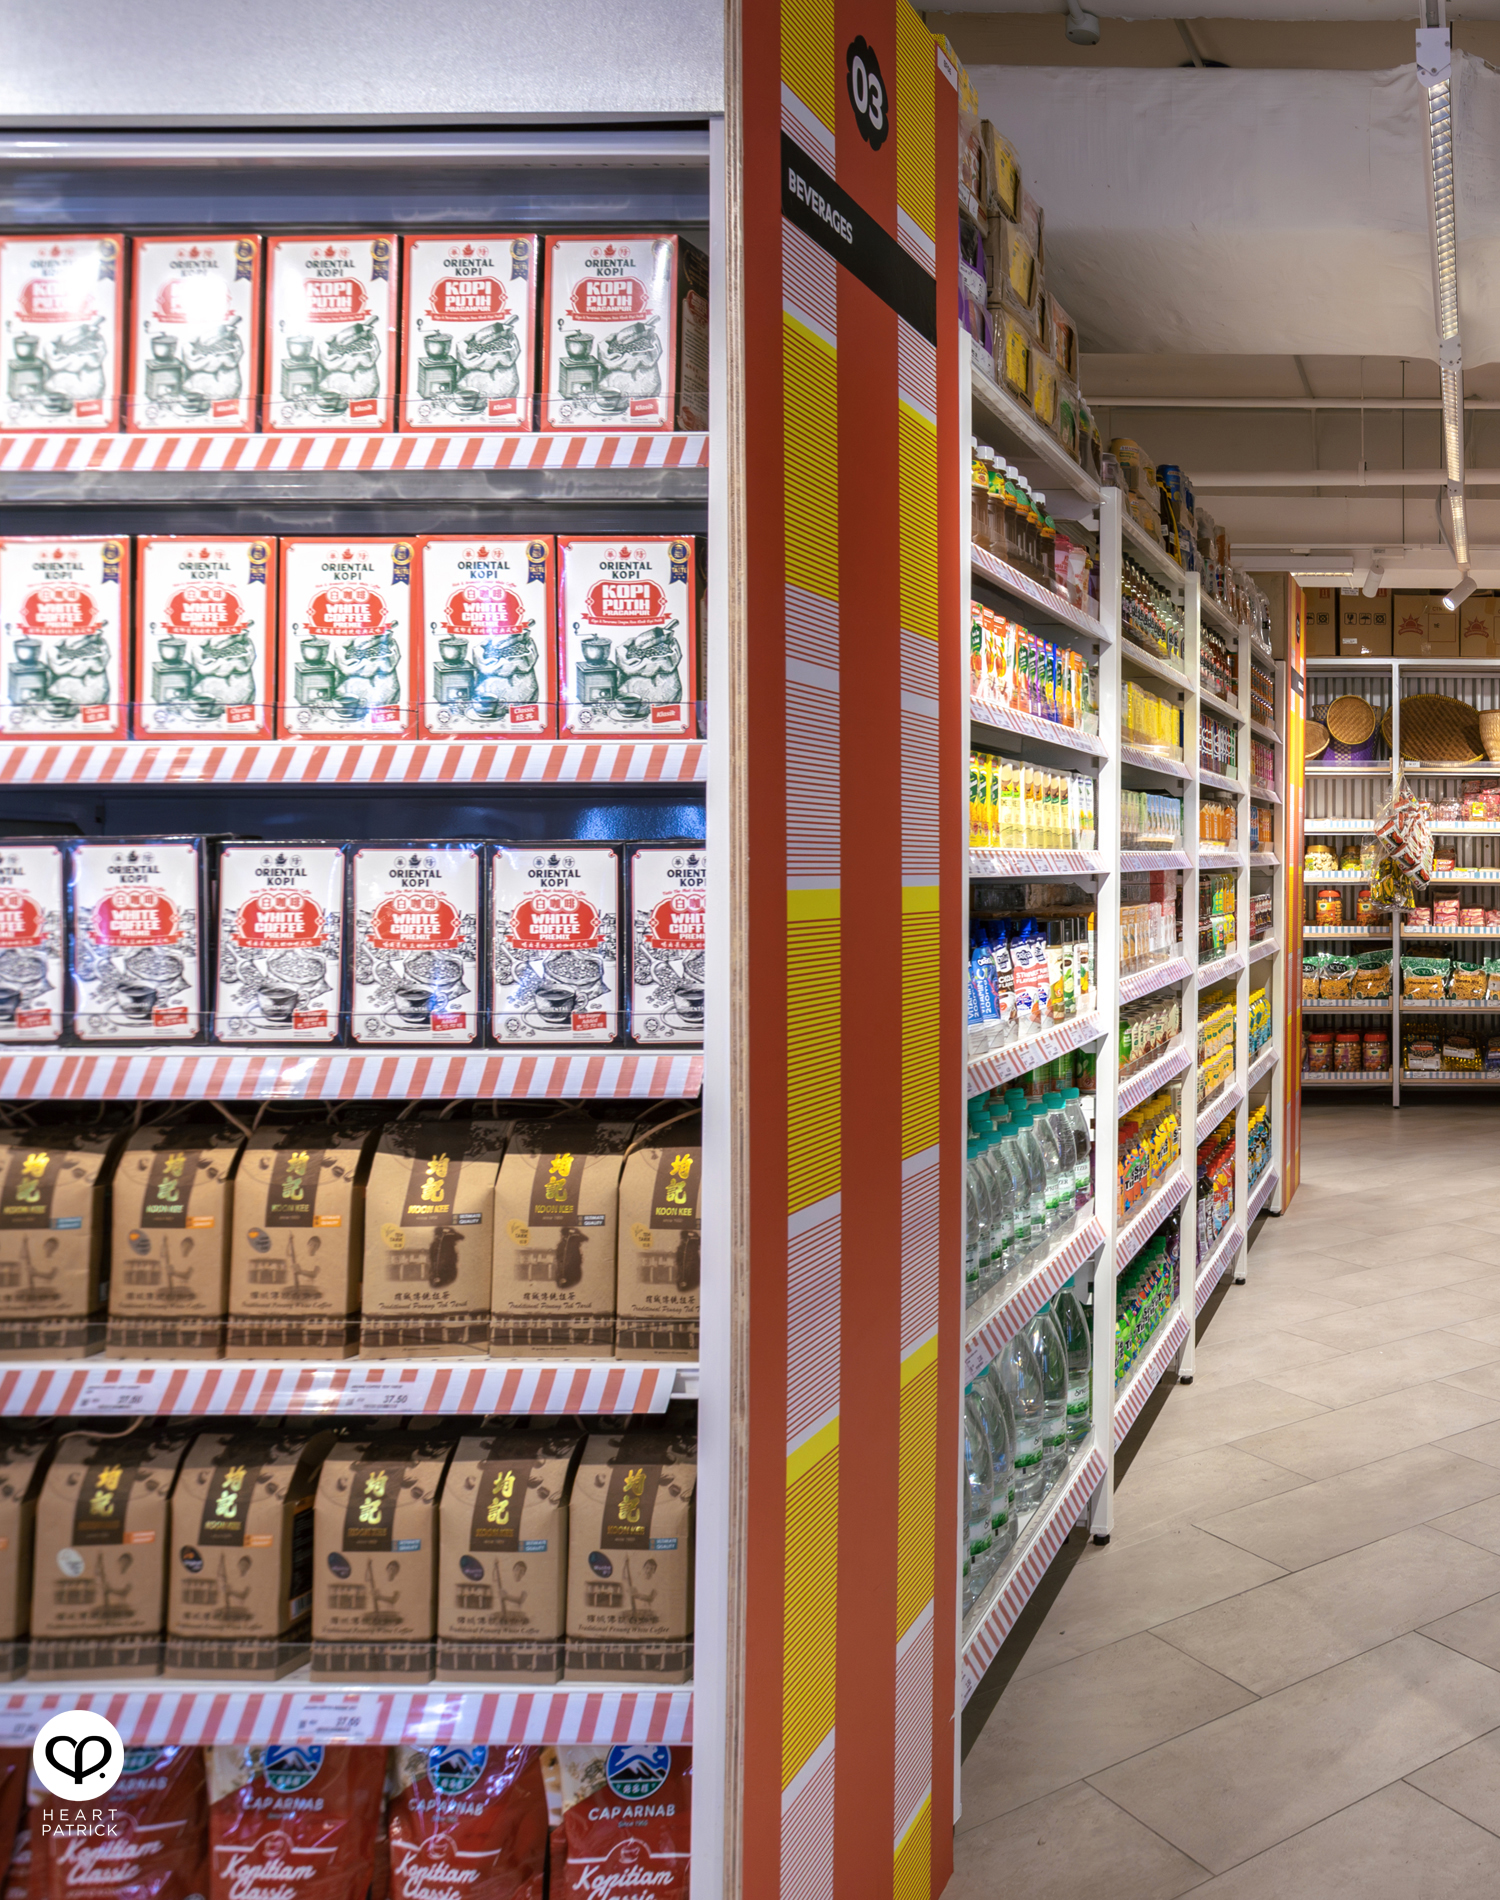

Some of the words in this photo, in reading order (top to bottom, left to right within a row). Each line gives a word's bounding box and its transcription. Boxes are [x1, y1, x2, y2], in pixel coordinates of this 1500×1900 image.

[851, 55, 884, 130] 03
[788, 167, 853, 244] BEVERAGES
[443, 258, 494, 268] ORIENTAL
[585, 259, 636, 268] ORIENTAL
[455, 268, 482, 276] KOPI
[596, 268, 624, 276] KOPI
[445, 282, 492, 295] KOPI
[586, 282, 633, 295] KOPI
[445, 296, 492, 306] PUTIH
[586, 296, 632, 306] PUTIH
[457, 561, 510, 570] ORIENTAL
[599, 561, 652, 571] ORIENTAL
[470, 570, 498, 579] KOPI
[612, 570, 640, 579] KOPI
[602, 584, 650, 599] KOPI
[462, 602, 506, 613] WHITE
[602, 599, 650, 610] PUTIH
[461, 612, 508, 622] COFFEE
[528, 869, 581, 878] ORIENTAL
[541, 878, 569, 887] KOPI
[532, 914, 578, 924] WHITE
[529, 924, 580, 934] COFFEE
[534, 1205, 557, 1213] KOON
[559, 1205, 574, 1213] KEE
[655, 1207, 675, 1216] KOON
[677, 1208, 692, 1216] KEE
[588, 1806, 622, 1821] CAP
[623, 1804, 676, 1819] ARNAB
[220, 1853, 316, 1882] Kopitiam
[394, 1851, 481, 1883] Kopitiam
[572, 1864, 674, 1898] Kopitiam
